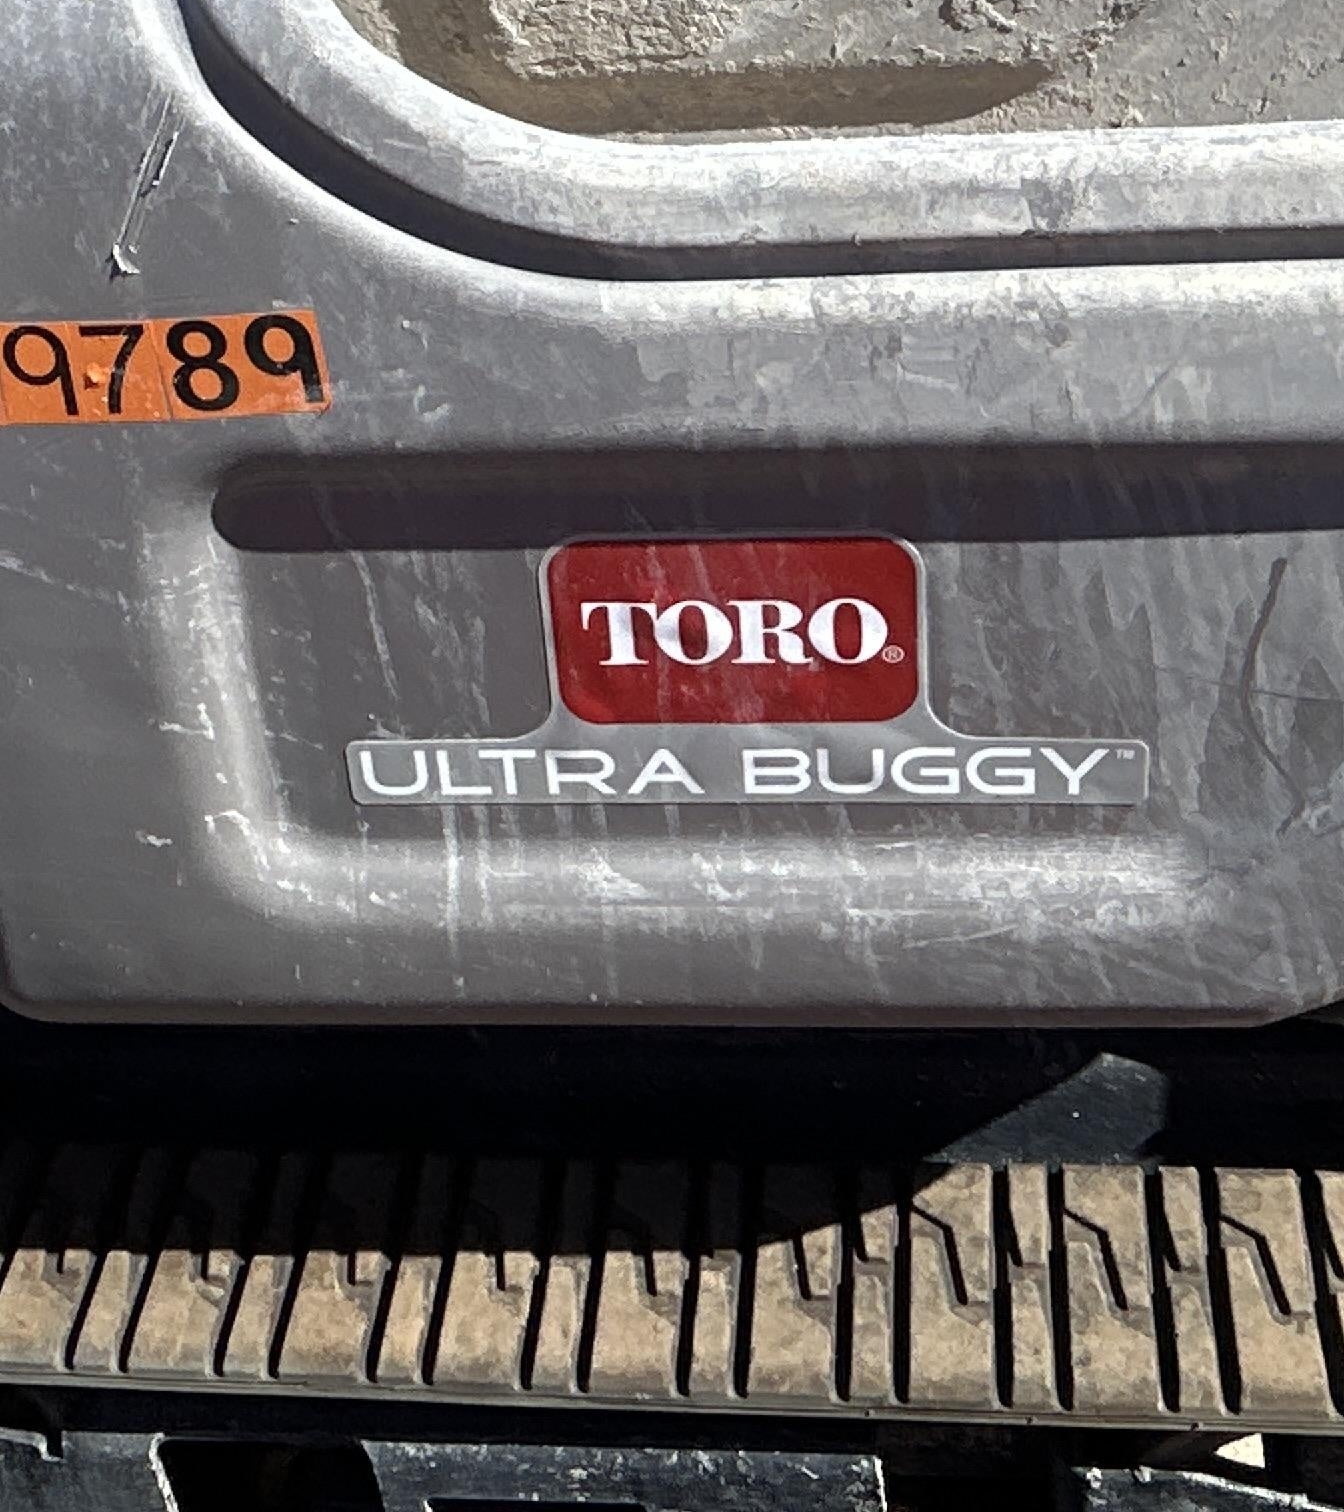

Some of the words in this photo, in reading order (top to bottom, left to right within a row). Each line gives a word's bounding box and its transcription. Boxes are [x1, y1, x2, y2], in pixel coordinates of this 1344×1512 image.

[580, 595, 888, 667] TORO
[358, 746, 707, 797] ULTRA
[742, 745, 1110, 796] BUGGY
